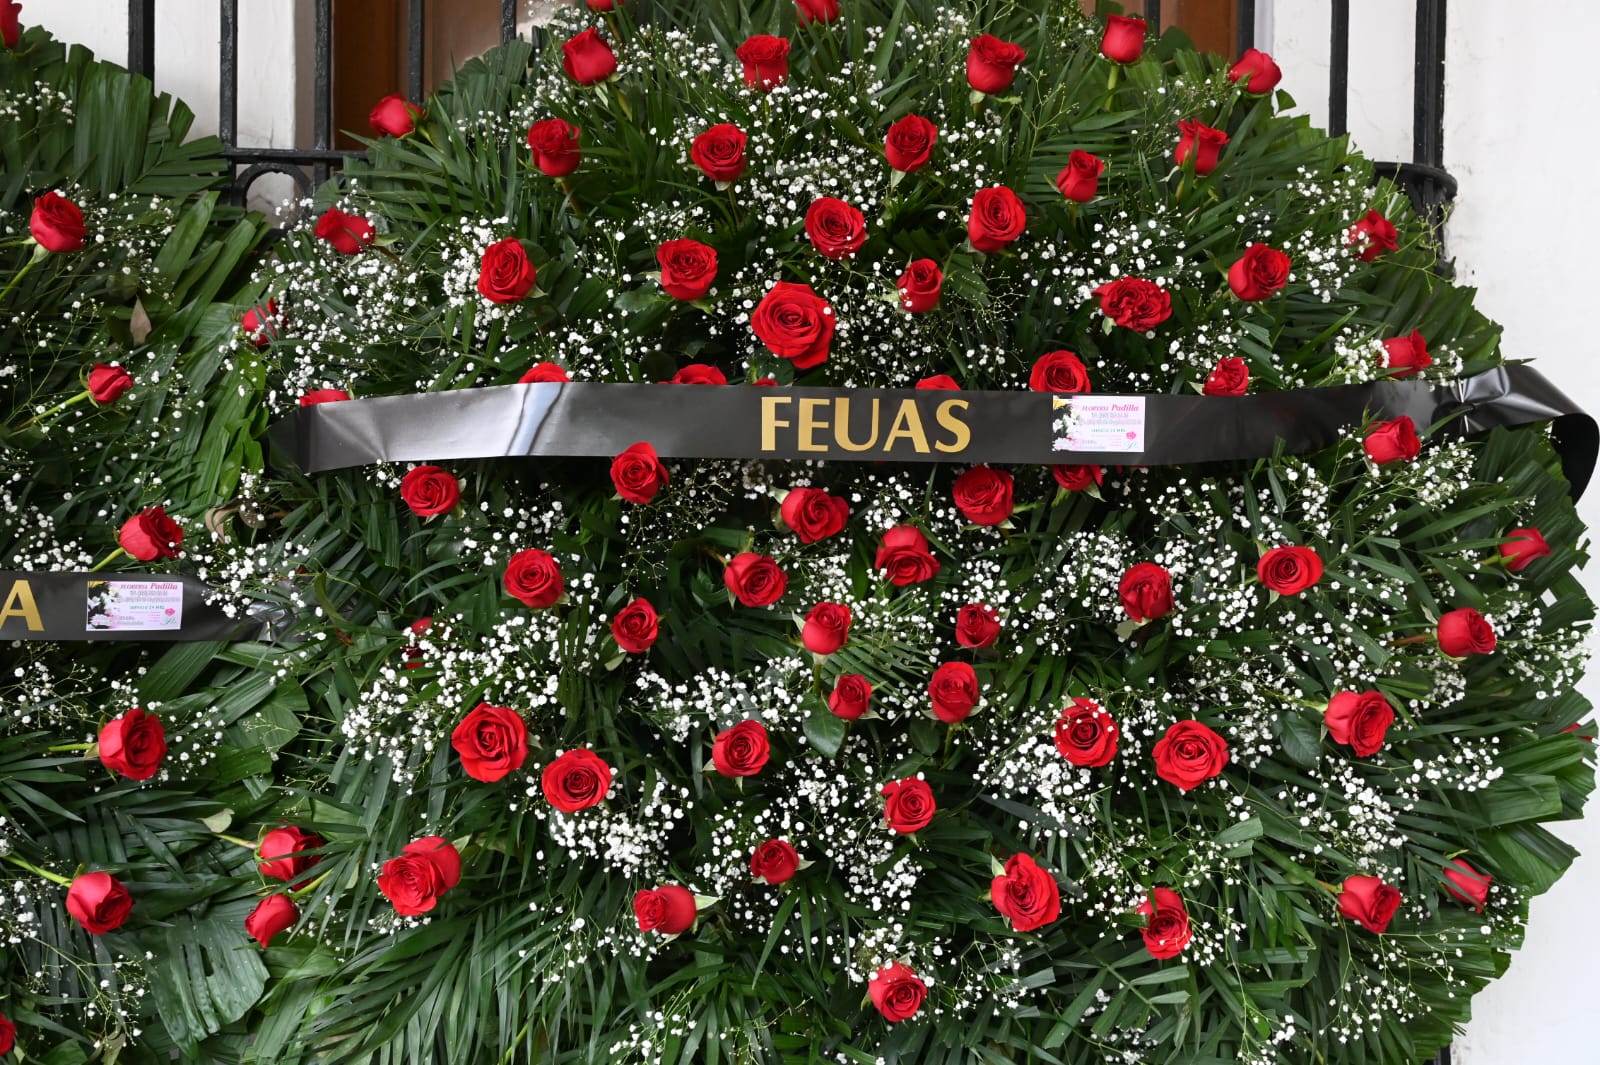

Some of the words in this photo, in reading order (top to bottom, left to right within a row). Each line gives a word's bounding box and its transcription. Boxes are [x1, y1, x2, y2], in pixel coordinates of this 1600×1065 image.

[1111, 403, 1140, 412] Padilla
[761, 396, 971, 453] FEUAS
[150, 582, 178, 590] Padilla
